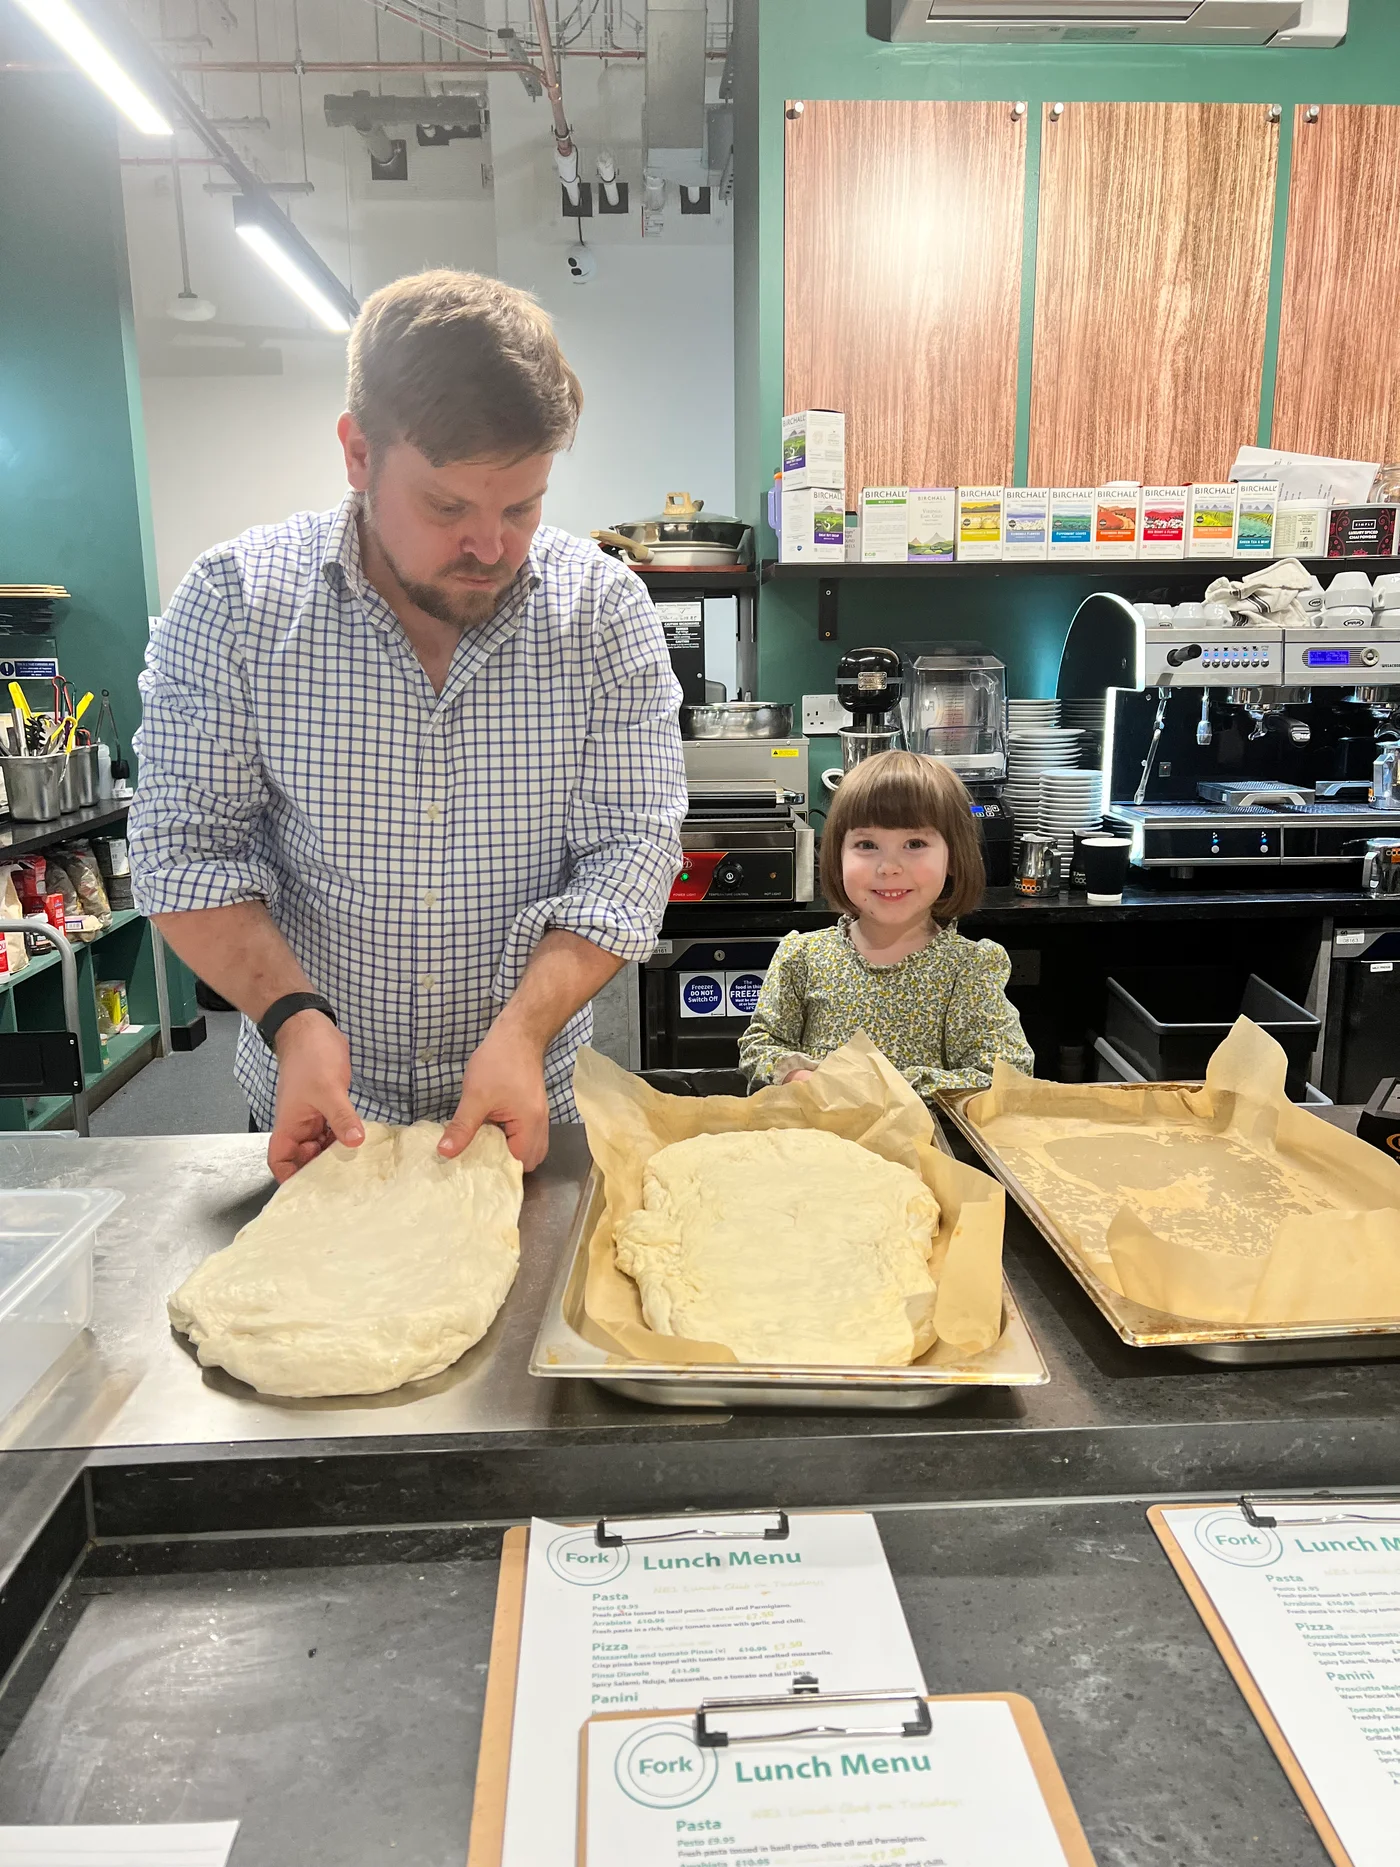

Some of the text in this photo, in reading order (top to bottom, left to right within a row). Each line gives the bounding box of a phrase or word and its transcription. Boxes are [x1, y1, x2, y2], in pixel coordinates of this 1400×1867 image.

[783, 415, 806, 427] BIRCHALL
[1195, 487, 1234, 495] BIRCHALL
[1240, 484, 1276, 492] BIRCHALL
[814, 491, 843, 499] BIRCHALL
[865, 490, 906, 498] BIRCHALL
[961, 490, 1000, 498] BIRCHALL
[1006, 491, 1045, 499] BIRCHALL
[1097, 490, 1137, 498] BIRCHALL
[1145, 489, 1185, 497] BIRCHALL
[730, 990, 761, 998] FREEZE
[1215, 1534, 1262, 1546] Fork
[1294, 1536, 1379, 1553] Lunch
[566, 1552, 609, 1564] Fork
[644, 1551, 802, 1571] Lunch Menu
[1265, 1574, 1304, 1582] Pasta
[592, 1593, 629, 1602] Pasta
[592, 1618, 632, 1626] Arrabiata
[1295, 1622, 1334, 1632] Pizza
[592, 1642, 629, 1652] Pizza
[616, 1670, 650, 1678] Diavola
[1326, 1670, 1375, 1681] Panini
[592, 1692, 639, 1704] Panini
[1360, 1726, 1390, 1734] Vegan
[639, 1756, 693, 1776] Fork
[735, 1753, 932, 1783] Lunch Menu
[676, 1820, 722, 1832] Pasta
[677, 1837, 736, 1848] Pesto £9.95
[678, 1850, 702, 1858] Fresh
[704, 1849, 728, 1858] pasta
[729, 1847, 758, 1855] tossed
[821, 1840, 842, 1849] olive
[856, 1838, 873, 1846] and
